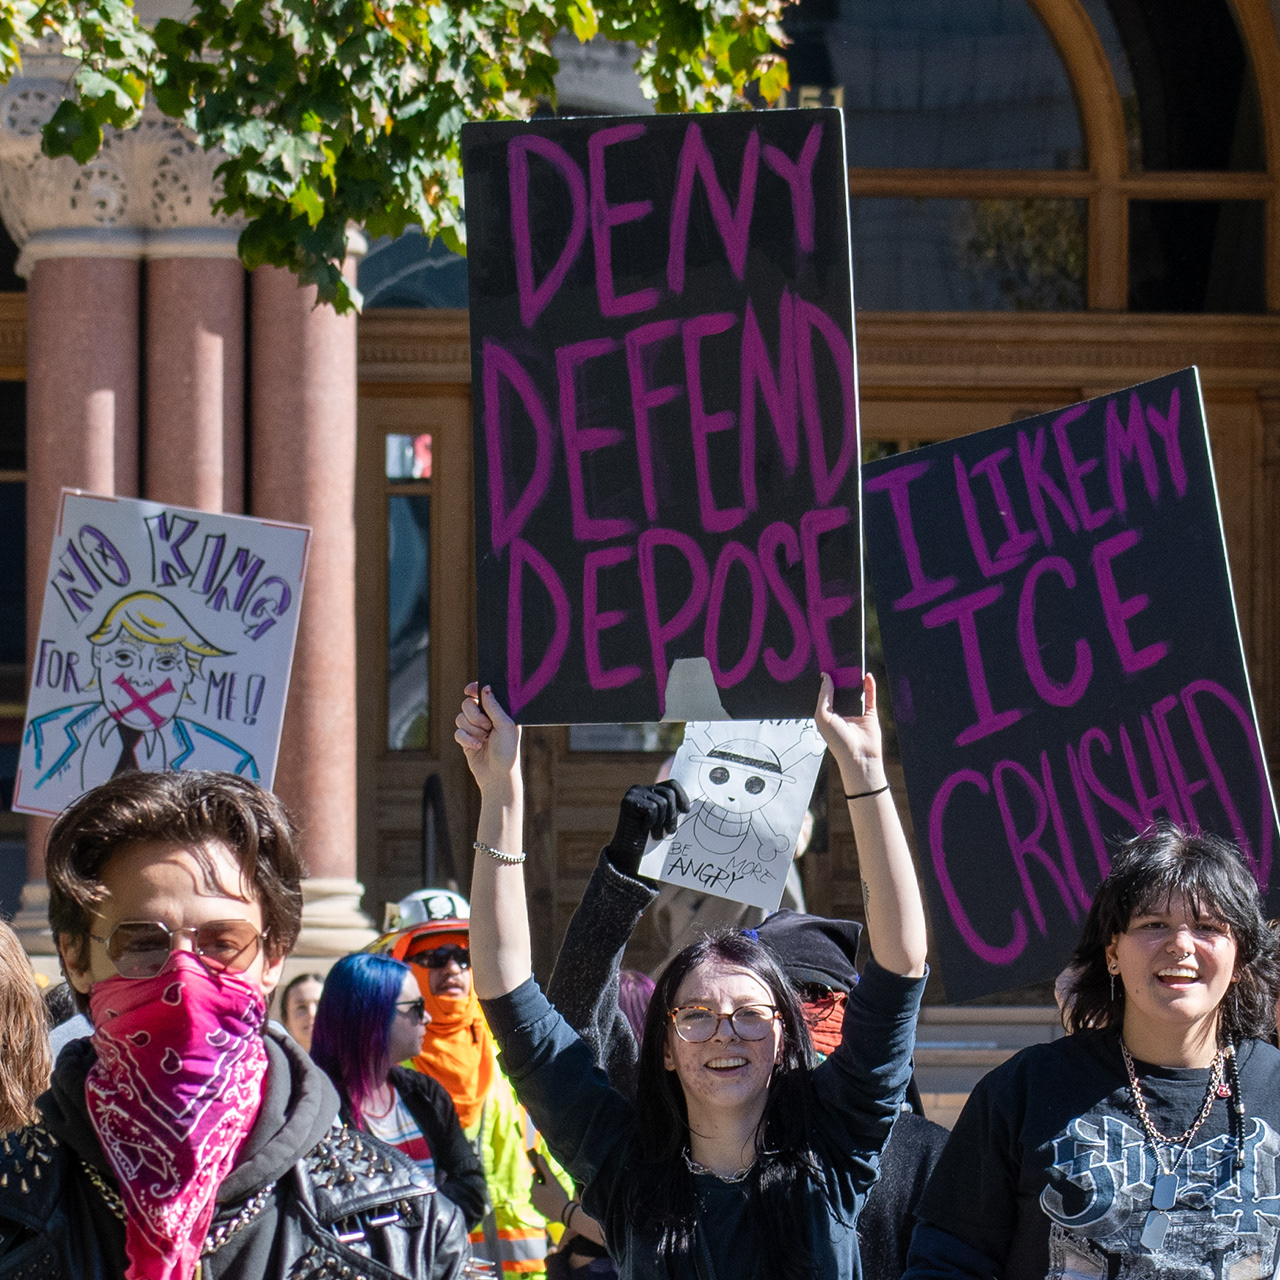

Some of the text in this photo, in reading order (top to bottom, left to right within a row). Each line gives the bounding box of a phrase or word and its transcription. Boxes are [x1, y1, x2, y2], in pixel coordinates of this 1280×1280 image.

[507, 121, 822, 329] DENY
[482, 285, 860, 557] DEFEND
[51, 512, 292, 641] NO KING
[864, 459, 959, 612] I
[36, 639, 81, 694] FOR
[507, 506, 864, 718] DEPOSE
[922, 528, 1170, 748] ICE
[203, 669, 266, 725] ME!
[668, 857, 744, 893] ANGRY
[670, 842, 692, 856] BE
[724, 856, 777, 884] MORE
[929, 679, 1272, 965] CRUSHED
